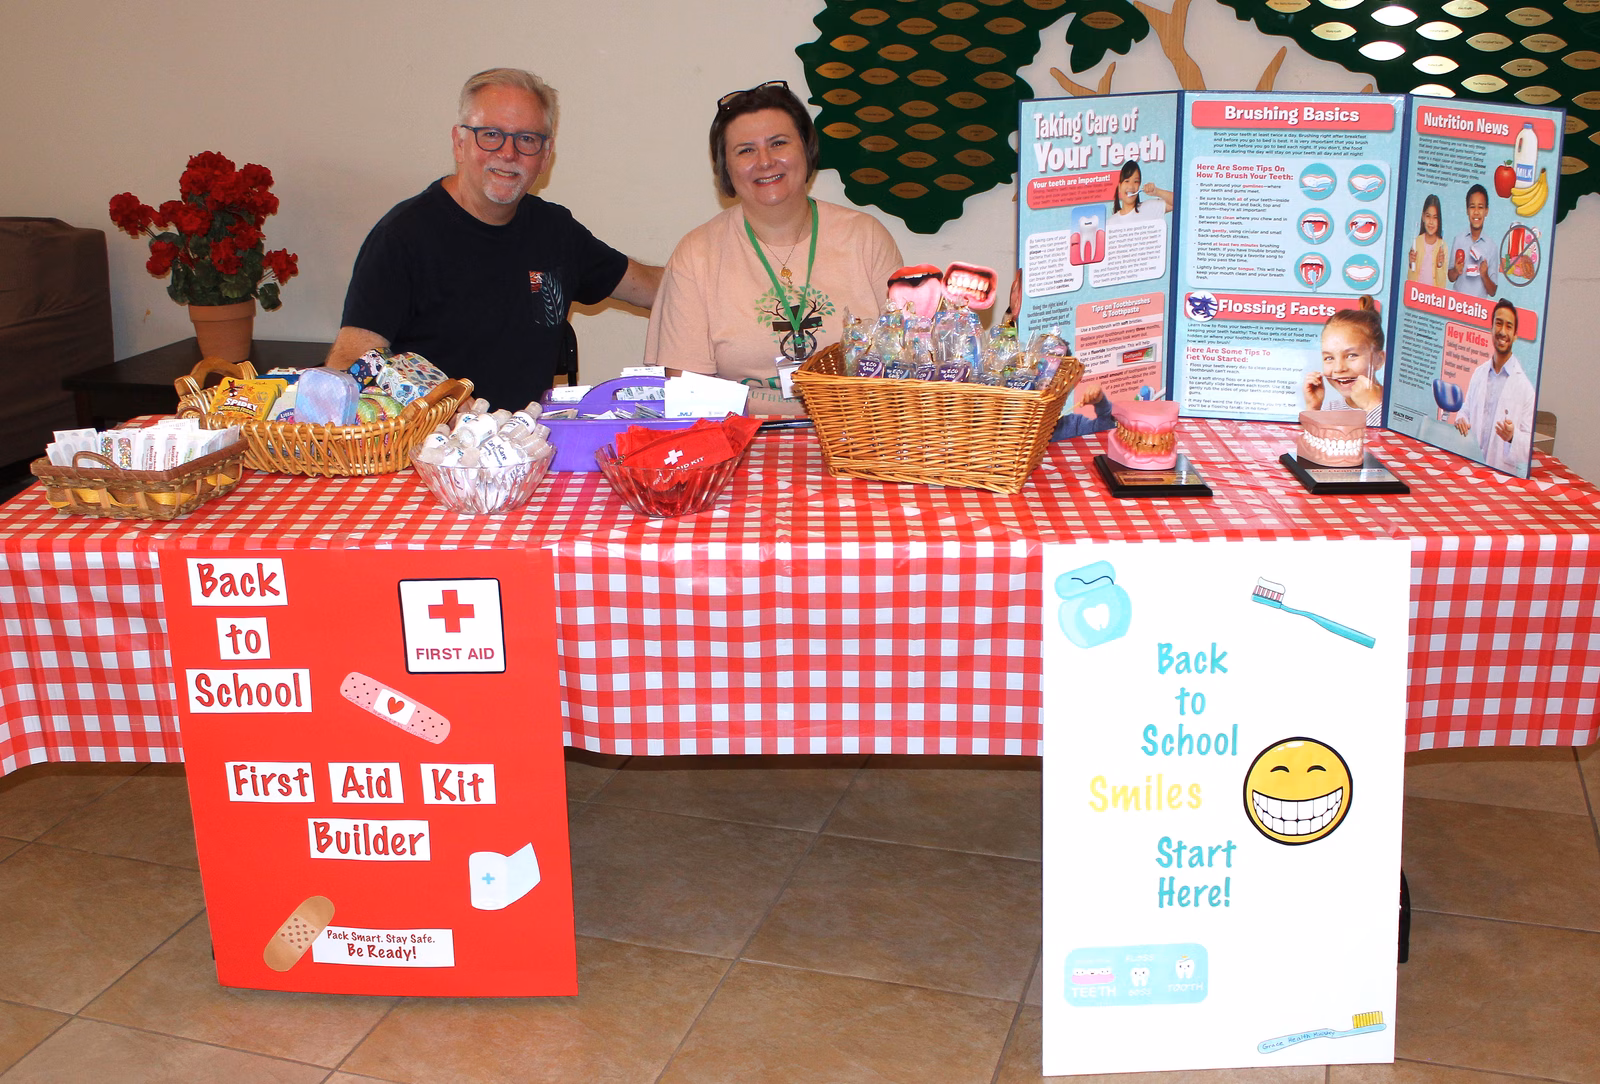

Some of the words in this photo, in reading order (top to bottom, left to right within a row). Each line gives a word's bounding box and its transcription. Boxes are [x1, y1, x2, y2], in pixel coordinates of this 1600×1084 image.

[1033, 111, 1082, 144] Taking
[1086, 109, 1119, 135] Care
[1122, 107, 1138, 132] of
[1224, 105, 1299, 125] Brushing
[1303, 107, 1360, 122] Basics
[1424, 112, 1474, 132] Nutrition
[1476, 118, 1509, 136] News
[1034, 142, 1092, 173] Your
[1097, 133, 1166, 167] Teeth
[1048, 179, 1066, 187] teeth
[1078, 174, 1110, 185] important!
[1517, 166, 1532, 179] MILK
[1092, 305, 1104, 314] Tips
[1113, 298, 1151, 309] Toothbrushes
[1108, 306, 1139, 318] Toothpaste
[1220, 299, 1286, 319] Flossing
[1290, 302, 1336, 316] Facts
[1411, 287, 1445, 309] Dental
[1448, 297, 1489, 320] Details
[1448, 327, 1464, 343] Hey
[1466, 332, 1488, 347] Kids:
[224, 398, 258, 411] SPIDEY
[691, 456, 704, 465] KIT
[196, 562, 280, 599] Back
[225, 623, 261, 655] to
[416, 647, 462, 660] FIRST
[467, 647, 494, 660] AID
[1157, 642, 1228, 674] Back
[194, 672, 301, 708] School
[1175, 687, 1206, 715] to
[1141, 724, 1238, 756] School
[232, 764, 310, 797] First
[341, 765, 394, 799] Aid
[431, 768, 485, 803] Kit
[1088, 773, 1203, 813] Smiles
[313, 820, 425, 857] Builder
[1155, 836, 1237, 869] Start
[1157, 876, 1231, 908] Here!
[326, 930, 349, 942] Pack
[351, 931, 384, 944] Smart.
[386, 932, 408, 946] Stay
[410, 932, 436, 944] Safe.
[347, 943, 364, 958] Be
[367, 945, 417, 961] Ready!
[1072, 986, 1116, 998] TEETH
[1262, 1041, 1284, 1050] Grace
[1288, 1033, 1311, 1043] Health
